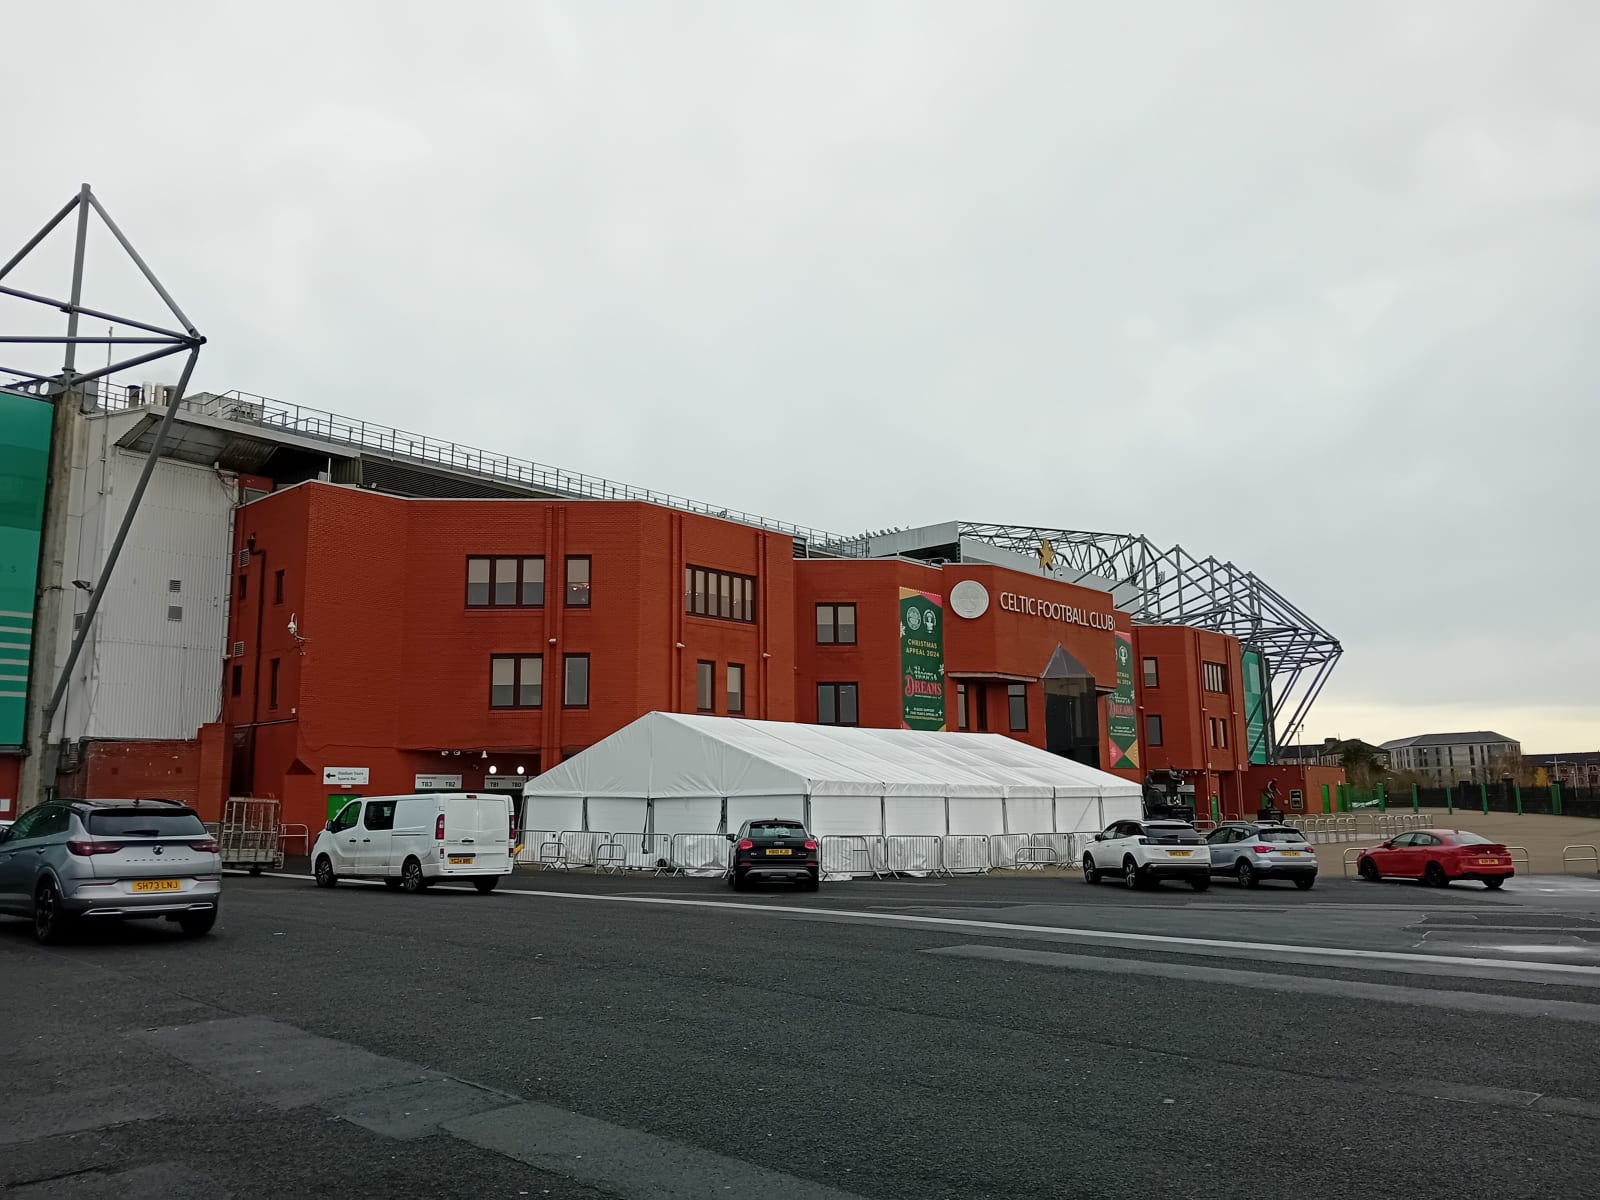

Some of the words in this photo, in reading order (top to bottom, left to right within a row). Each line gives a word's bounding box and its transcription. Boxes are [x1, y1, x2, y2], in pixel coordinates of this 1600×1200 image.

[1000, 592, 1036, 615] CELTIC
[1037, 600, 1089, 626] FOOTBALL
[1089, 611, 1113, 631] CLUB
[907, 638, 937, 649] CHRISTMAS
[905, 647, 926, 656] APPEAL
[926, 650, 940, 658] 2024
[905, 674, 942, 697] DREAMS
[136, 882, 160, 890] SH73
